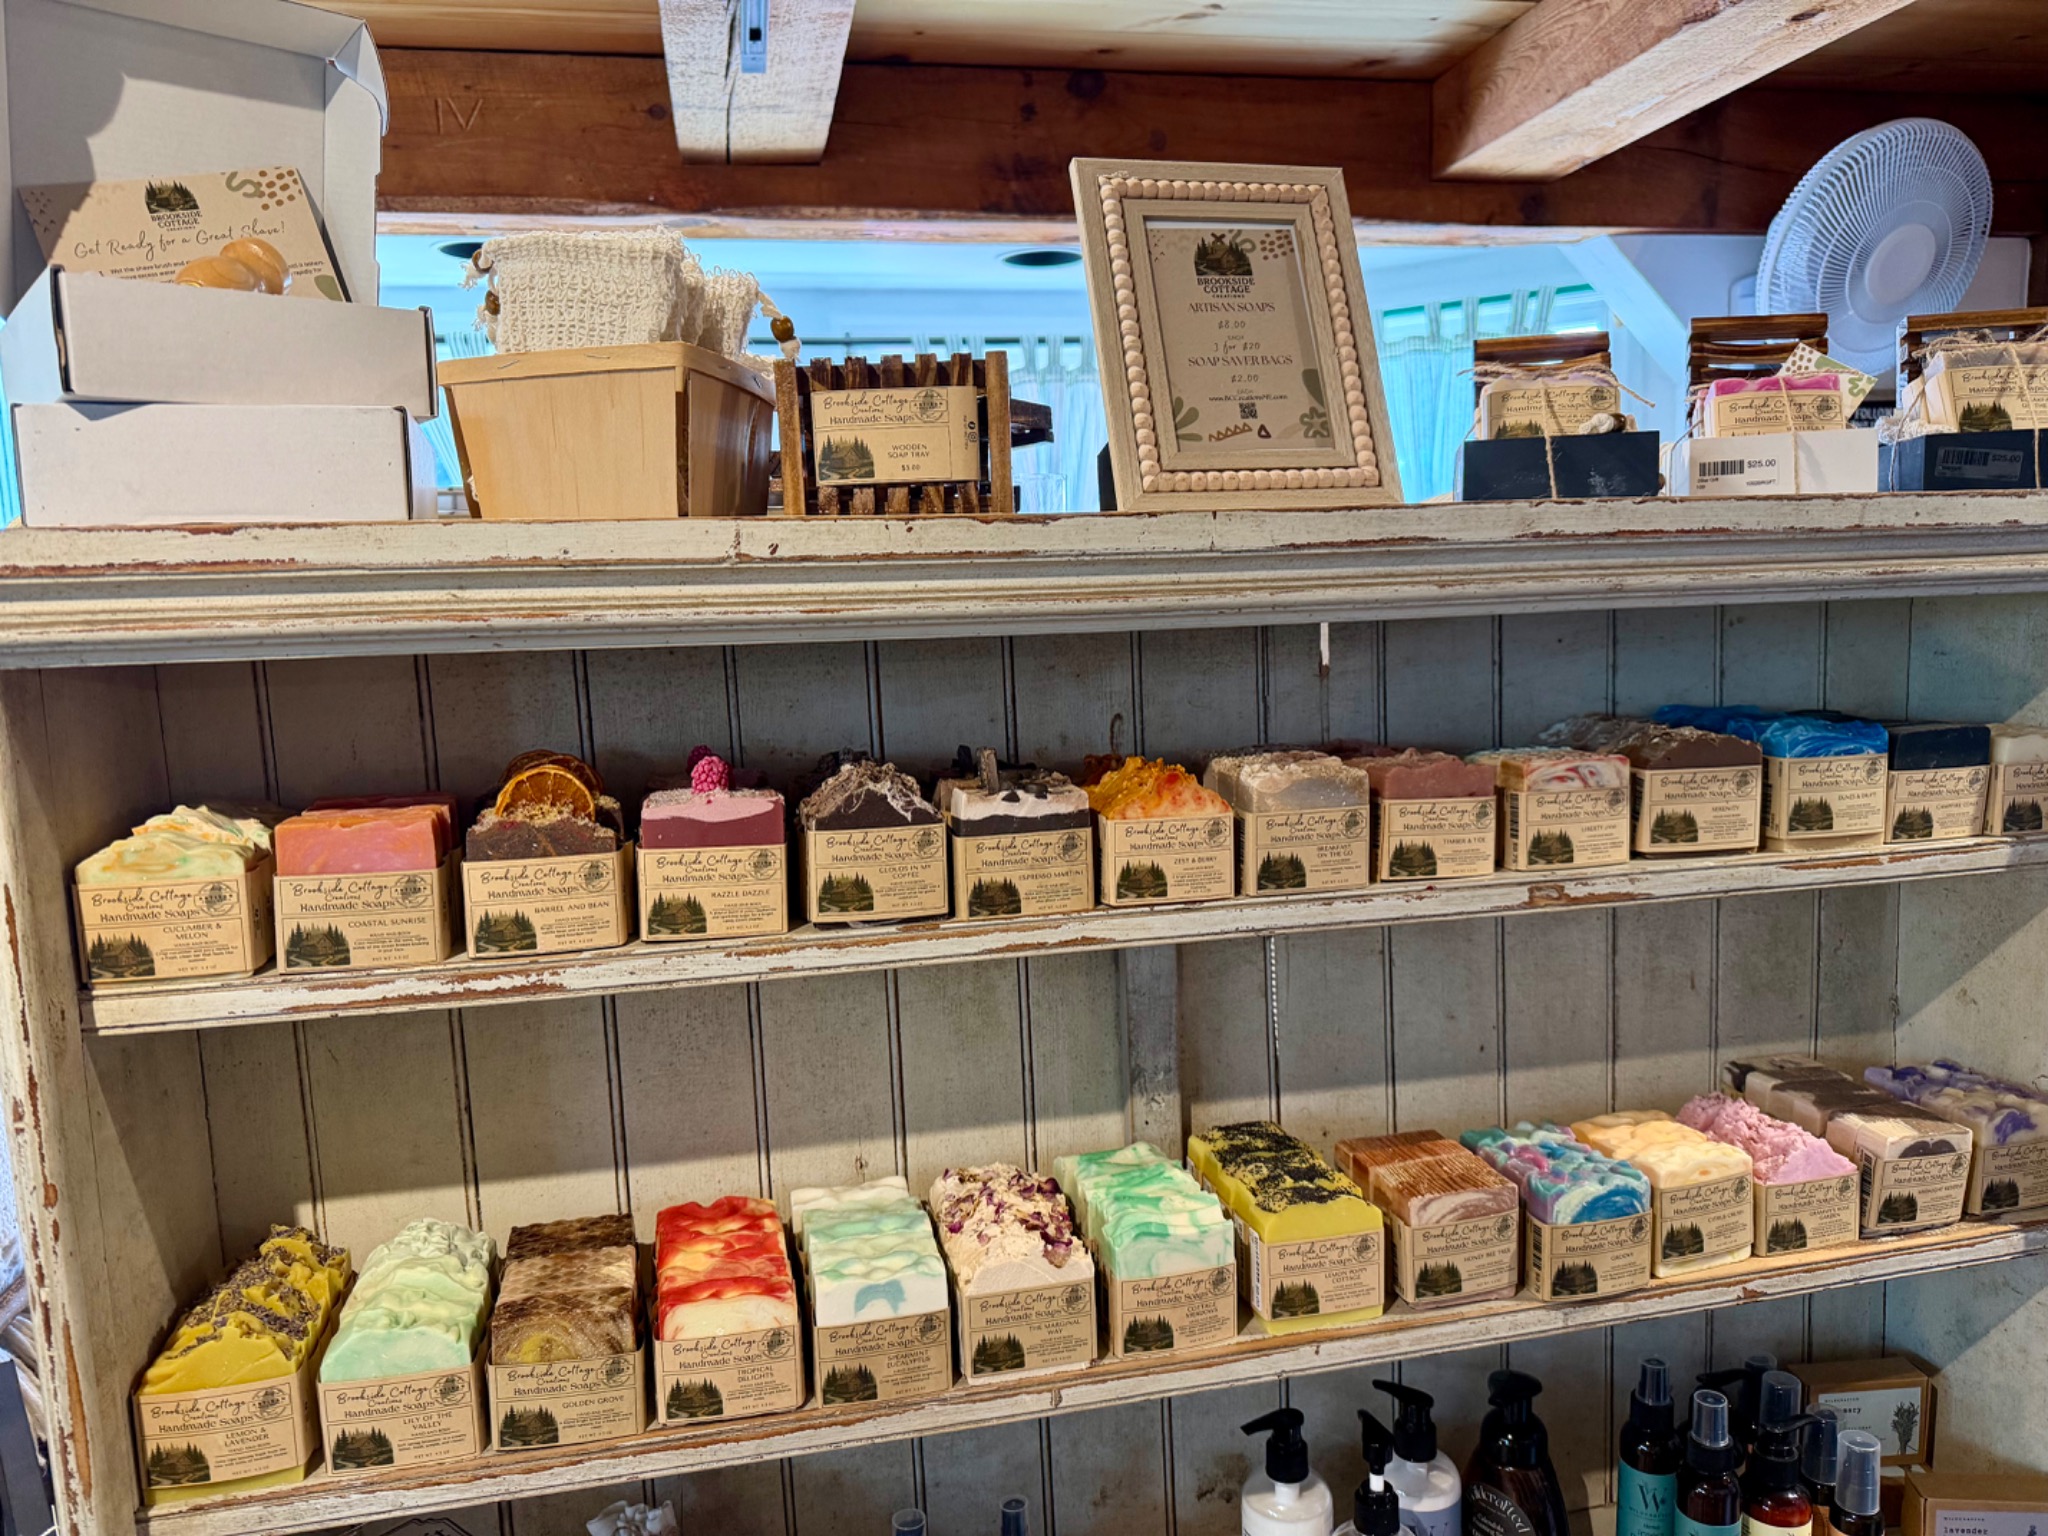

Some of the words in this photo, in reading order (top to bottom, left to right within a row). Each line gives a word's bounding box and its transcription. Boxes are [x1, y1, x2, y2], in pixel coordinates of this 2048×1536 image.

[150, 212, 203, 222] BROOKSIDE
[158, 217, 200, 228] COTTAGE
[74, 242, 100, 258] Get
[106, 230, 154, 261] Ready
[159, 234, 176, 252] for
[181, 236, 190, 244] a
[196, 226, 233, 245] Great
[240, 221, 285, 238] Shave!
[1203, 285, 1250, 293] COTTAGE
[1188, 303, 1236, 312] ARTISAN
[1237, 302, 1275, 312] SOAPS
[1218, 320, 1246, 329] $8.00
[1223, 341, 1236, 354] for
[1188, 356, 1220, 367] SOAP
[1222, 356, 1260, 366] SAVER
[1262, 355, 1293, 365] BAGS
[1231, 374, 1259, 383] $2.00
[1962, 370, 2004, 383] Brookside
[824, 392, 868, 409] Brookside
[872, 394, 908, 413] Cottage
[1729, 398, 1770, 413] Brookside
[830, 415, 881, 425] Handmade
[885, 414, 915, 424] Soaps
[1734, 414, 1783, 424] Handmade
[1747, 459, 1776, 468] $25.00
[1991, 454, 2021, 462] $25.00
[826, 832, 869, 848] Brookside
[874, 834, 907, 851] Cottage
[657, 851, 702, 868] Brookside
[707, 855, 743, 872] Cottage
[832, 854, 882, 862] Handmade
[885, 852, 912, 860] Soaps
[481, 866, 529, 883] Brookside
[533, 867, 572, 885] Cottage
[663, 875, 716, 883] Handmade
[292, 878, 343, 896] Brookside
[347, 881, 389, 899] Cottage
[488, 889, 544, 899] Handmade
[548, 886, 580, 895] Soaps
[92, 888, 145, 907] Brookside
[150, 889, 192, 908] Cottage
[300, 902, 359, 912] Handmade
[362, 901, 396, 911] Soaps
[535, 906, 564, 914] BARREL
[100, 911, 161, 922] Handmade
[165, 909, 200, 919] Soaps
[163, 923, 212, 933] CUCUMBER
[348, 920, 387, 928] COASTAL
[176, 932, 208, 940] MELON
[673, 1337, 717, 1355] Brookside
[721, 1338, 756, 1354] Cottage
[679, 1358, 730, 1369] Handmade
[733, 1354, 763, 1363] Soaps
[508, 1364, 553, 1381] Brookside
[558, 1365, 596, 1381] Cottage
[738, 1366, 773, 1376] TROPICAL
[738, 1372, 774, 1383] DELIGHTS
[337, 1385, 385, 1404] Brookside
[390, 1385, 428, 1401] Cottage
[514, 1385, 567, 1396] Handmade
[571, 1383, 601, 1392] Soaps
[151, 1399, 201, 1419] Brookside
[205, 1399, 246, 1415] Cottage
[344, 1406, 400, 1418] Handmade
[403, 1401, 436, 1411] Soaps
[562, 1400, 595, 1408] GOLDEN
[159, 1421, 217, 1433] Handmade
[219, 1416, 253, 1426] Soaps
[403, 1417, 420, 1425] LILY
[412, 1422, 442, 1430] VALLEY
[226, 1429, 257, 1438] LEMON
[225, 1434, 269, 1447] LAVENDER
